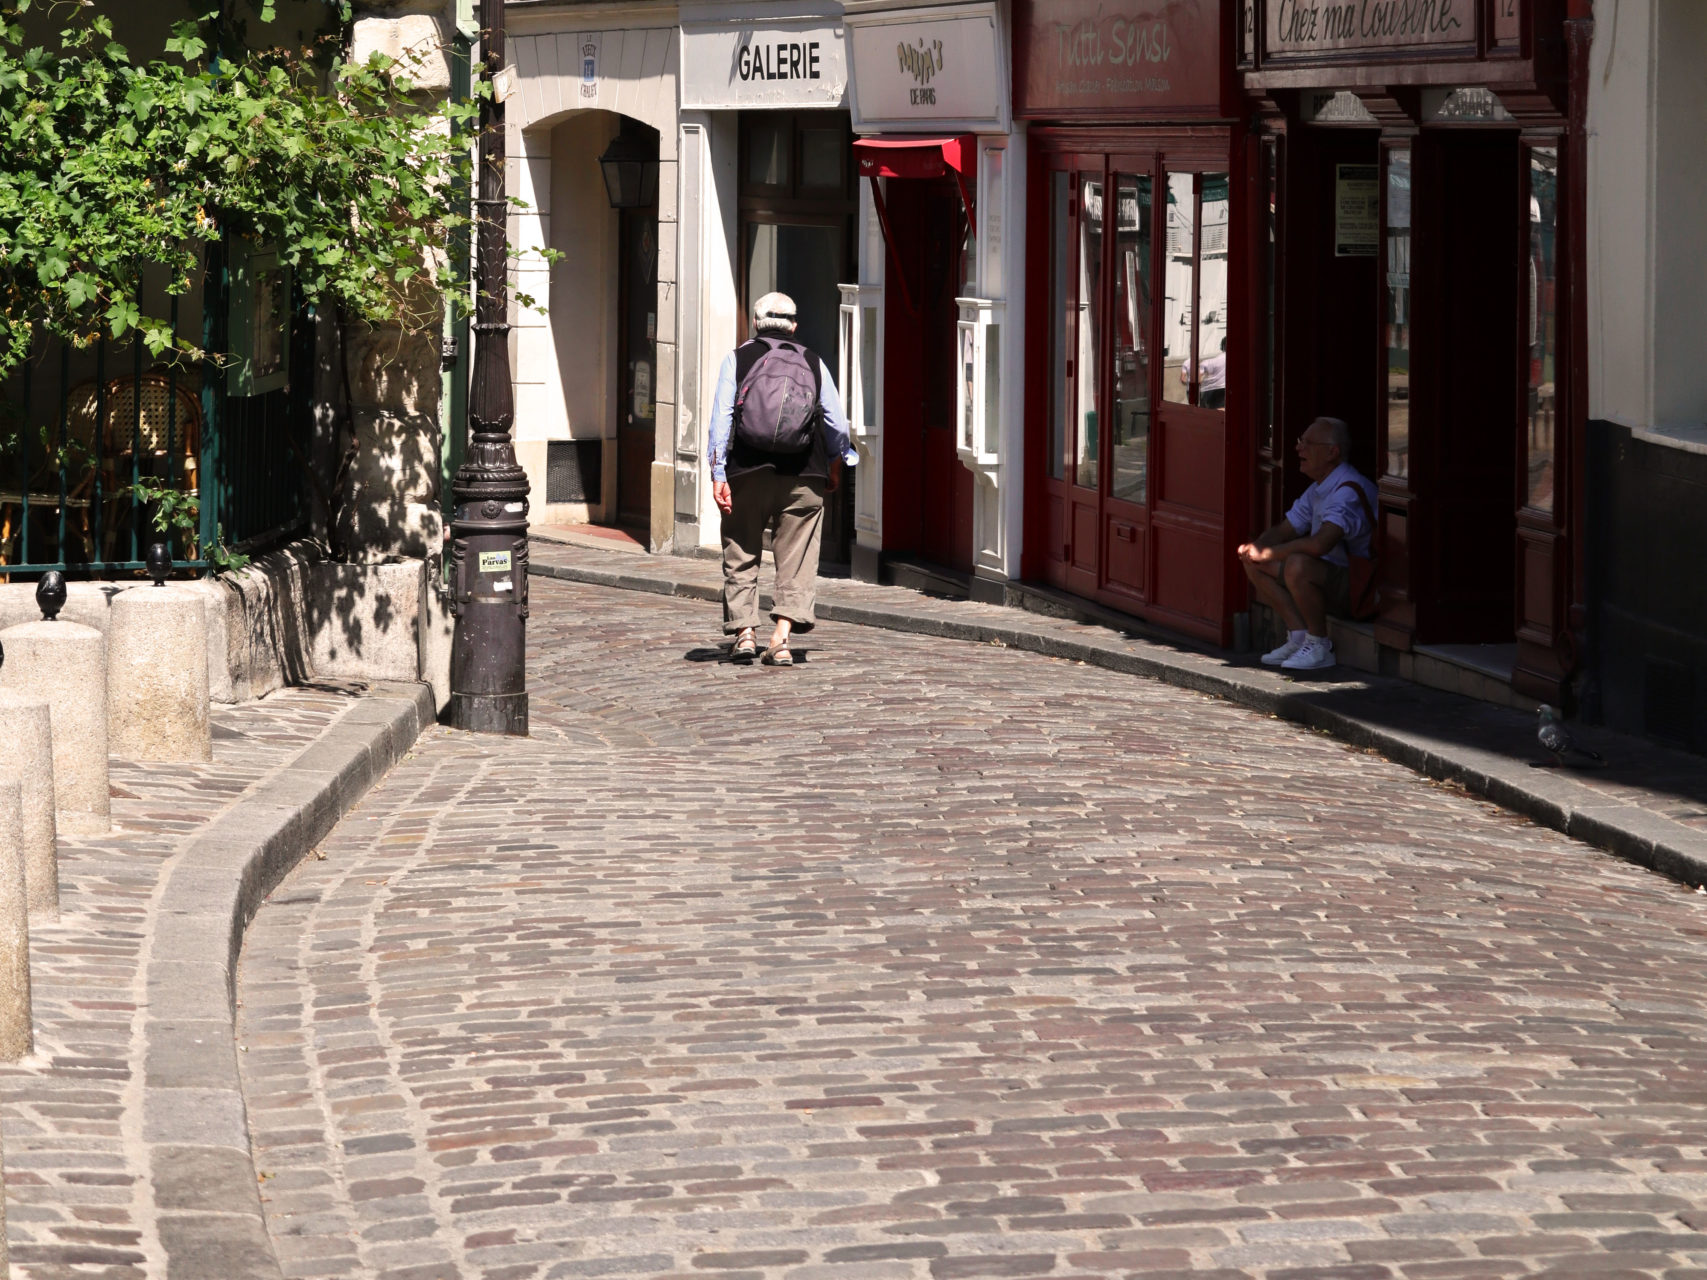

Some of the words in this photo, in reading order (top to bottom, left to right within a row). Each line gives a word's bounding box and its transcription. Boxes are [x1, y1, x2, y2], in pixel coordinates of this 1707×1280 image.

[1055, 4, 1104, 70] Tutti
[1108, 4, 1171, 67] Sensi
[1244, 5, 1253, 34] 12
[1323, 3, 1355, 41] ma
[738, 42, 821, 81] GALERIE
